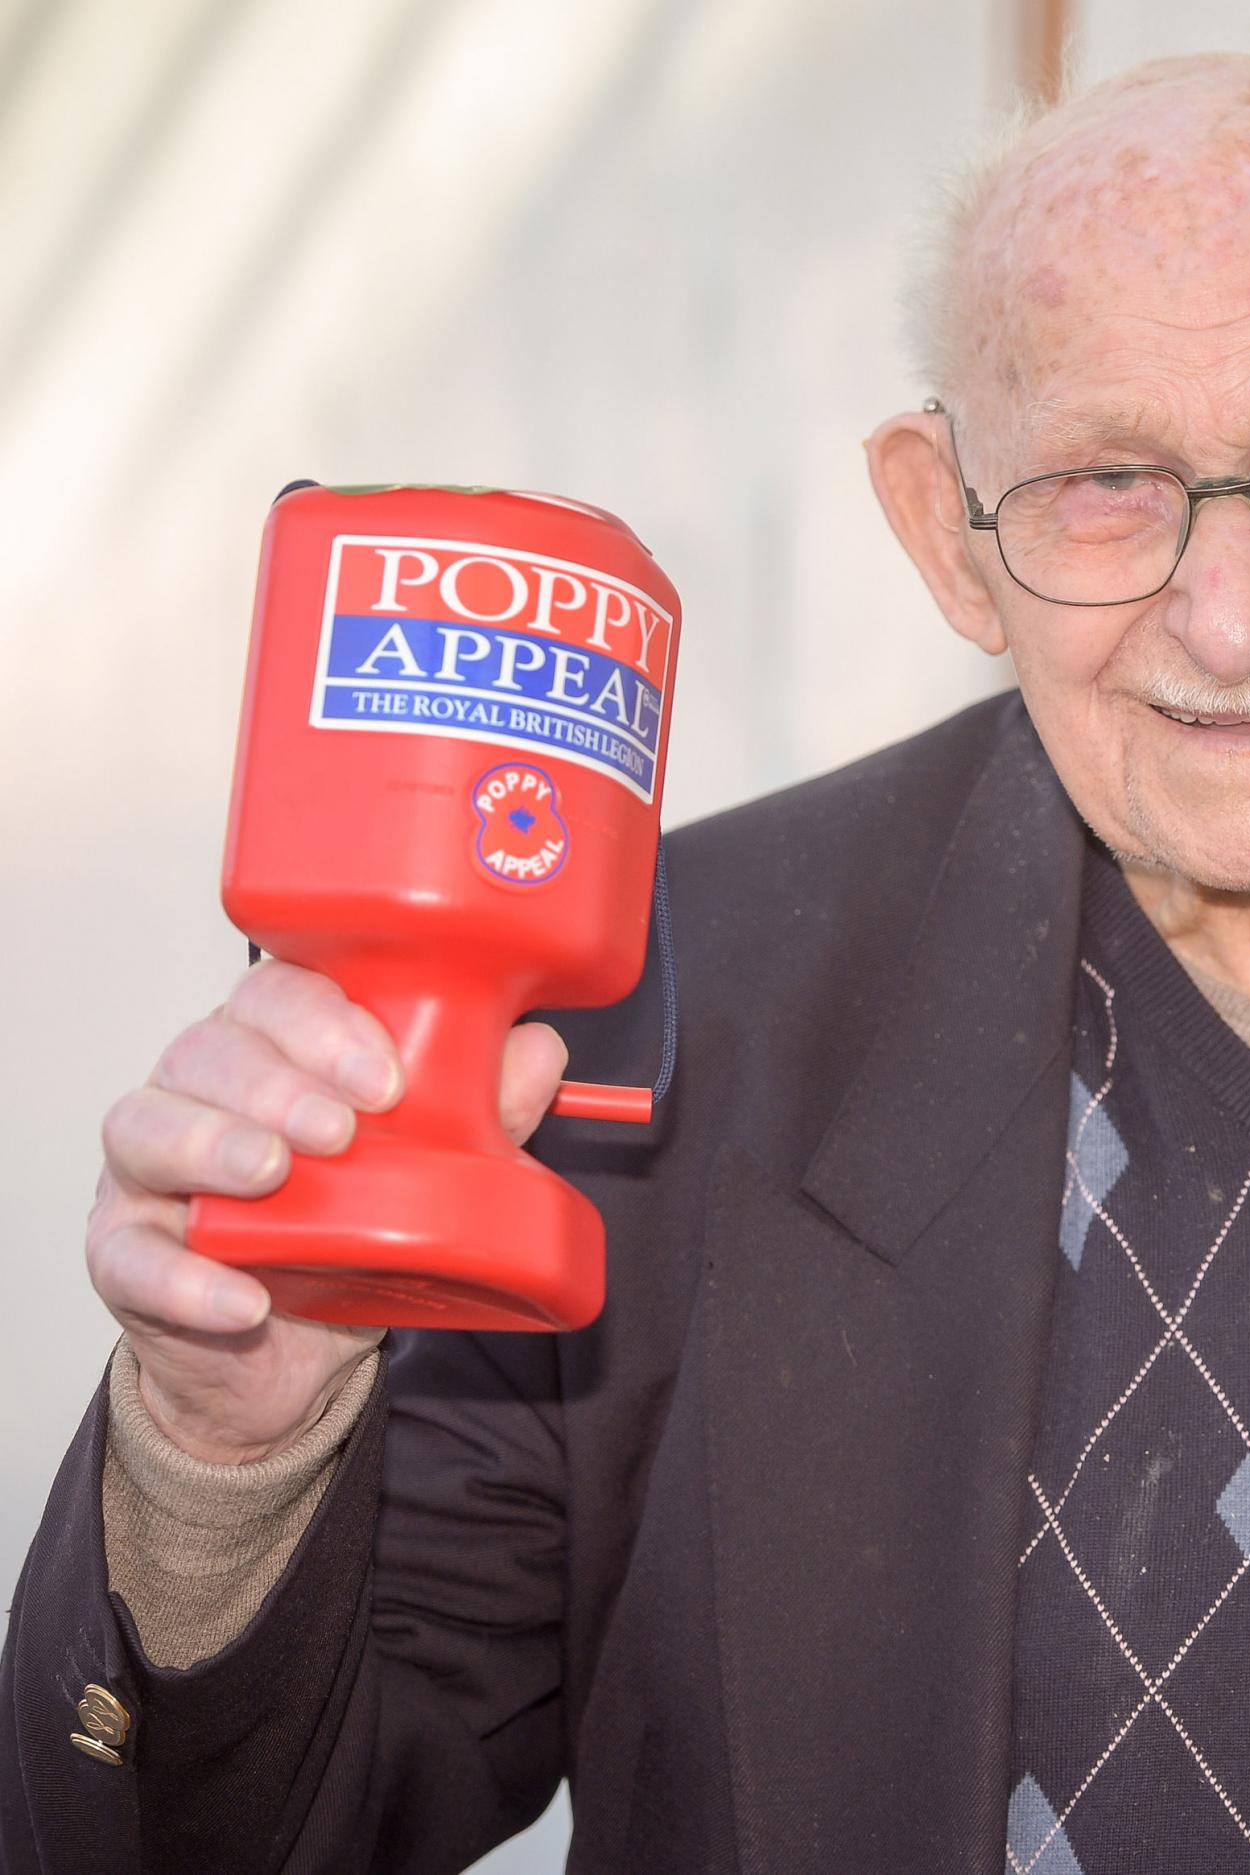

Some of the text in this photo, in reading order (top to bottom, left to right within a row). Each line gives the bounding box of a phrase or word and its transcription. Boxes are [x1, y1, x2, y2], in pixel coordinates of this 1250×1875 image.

[371, 548, 663, 676] POPPY
[356, 623, 650, 738] APPEAL
[352, 691, 646, 776] THE ROYAL BRITISH LEGION
[476, 771, 552, 813] POPPY
[485, 839, 564, 879] APPEAL
